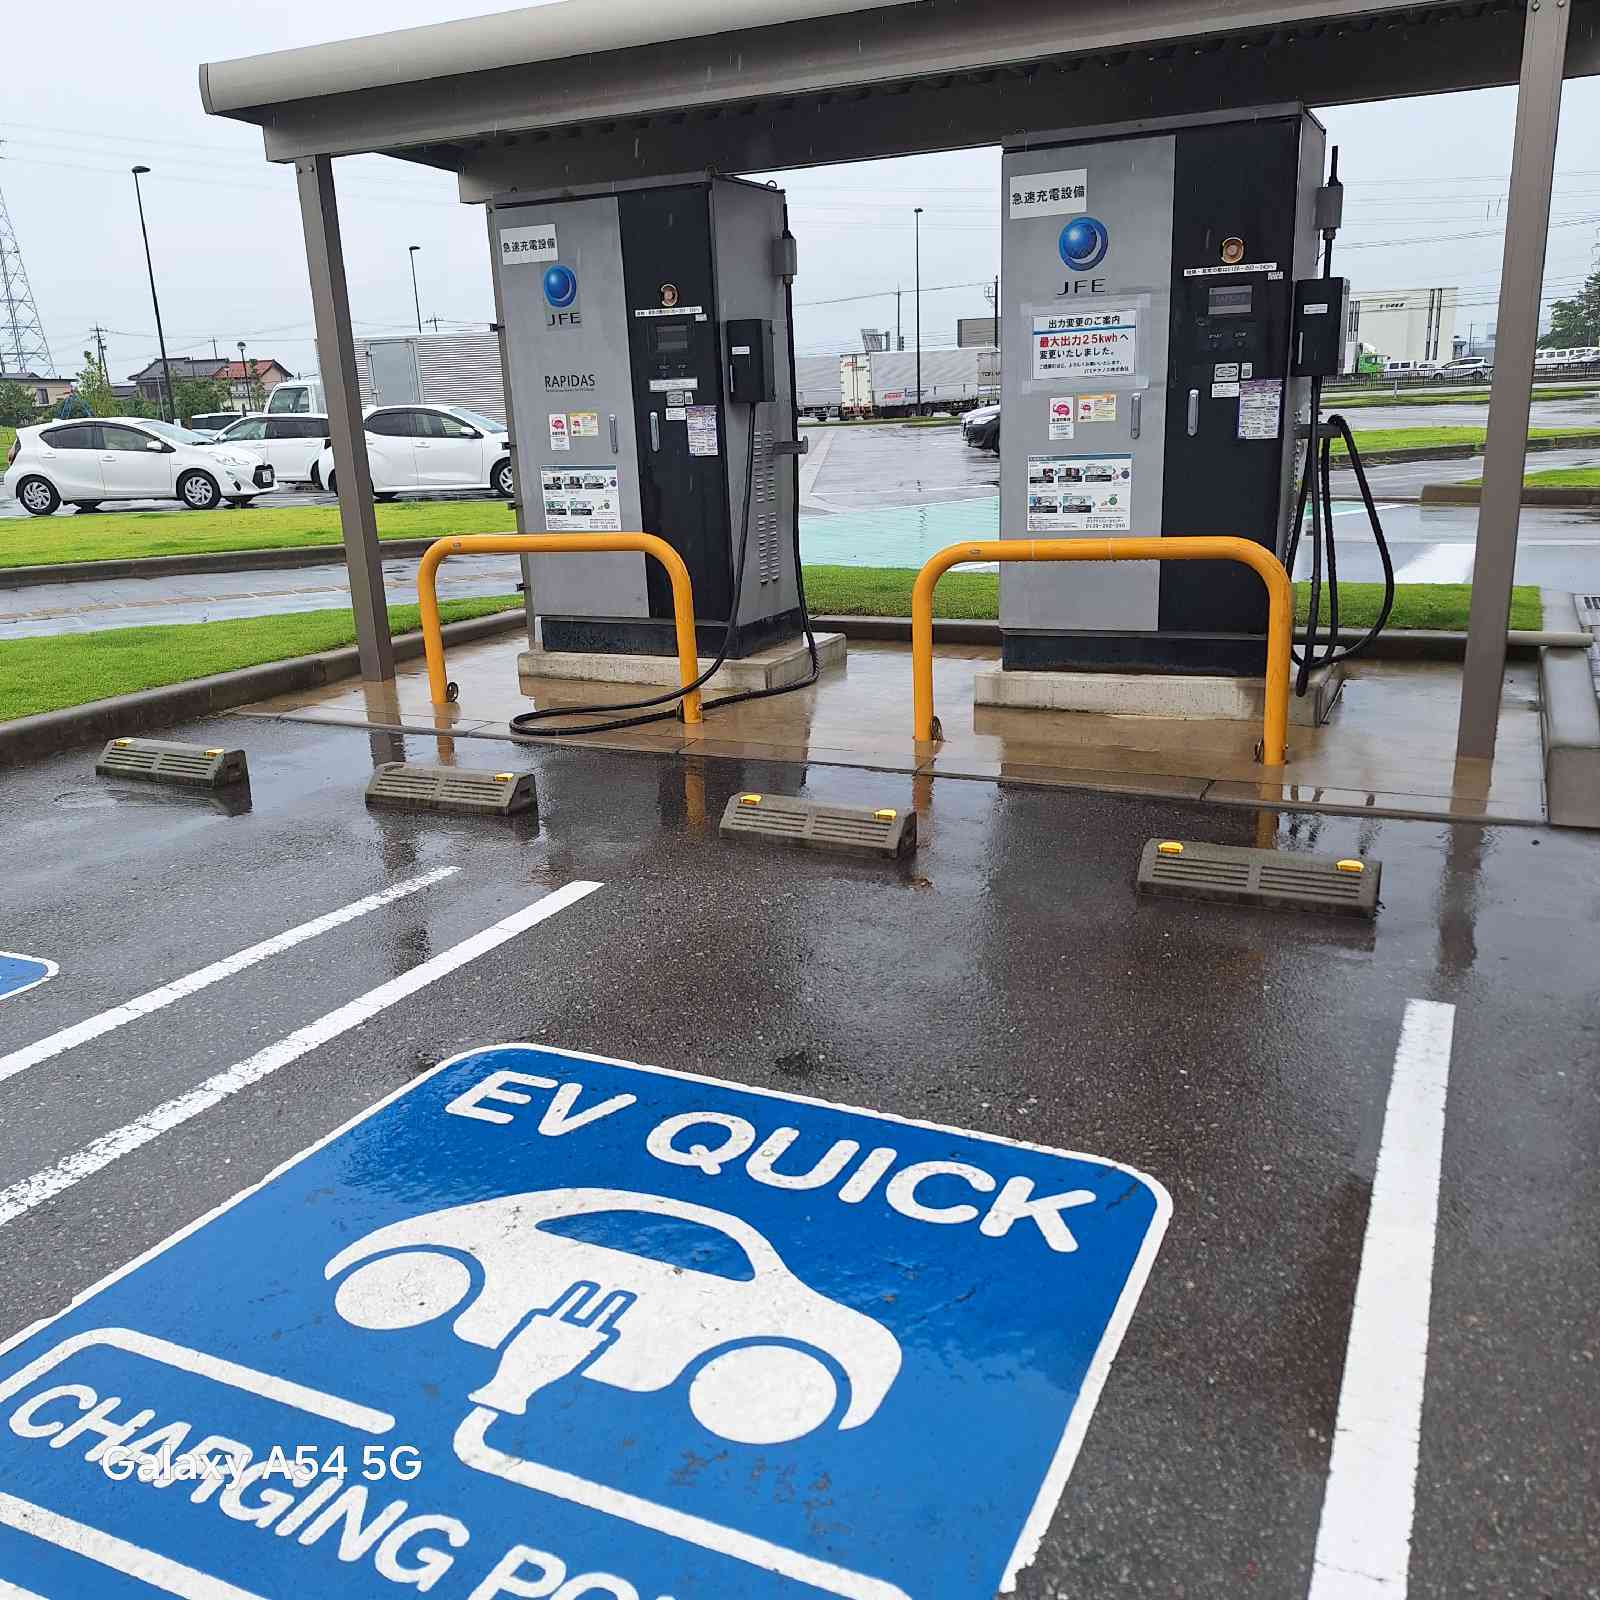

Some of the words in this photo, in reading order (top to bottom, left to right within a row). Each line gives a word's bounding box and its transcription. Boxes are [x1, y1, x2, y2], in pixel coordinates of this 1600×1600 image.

[1012, 185, 1085, 205] 急速充電設備
[503, 238, 556, 253] 急速充電設備
[1056, 278, 1106, 296] JFE
[547, 312, 581, 326] JFE
[1048, 315, 1121, 329] 出力変更のご案内
[544, 374, 596, 388] RAPIDAS
[445, 1070, 636, 1137] EV
[646, 1111, 1097, 1253] QUICK
[9, 1383, 470, 1592] CHARGING
